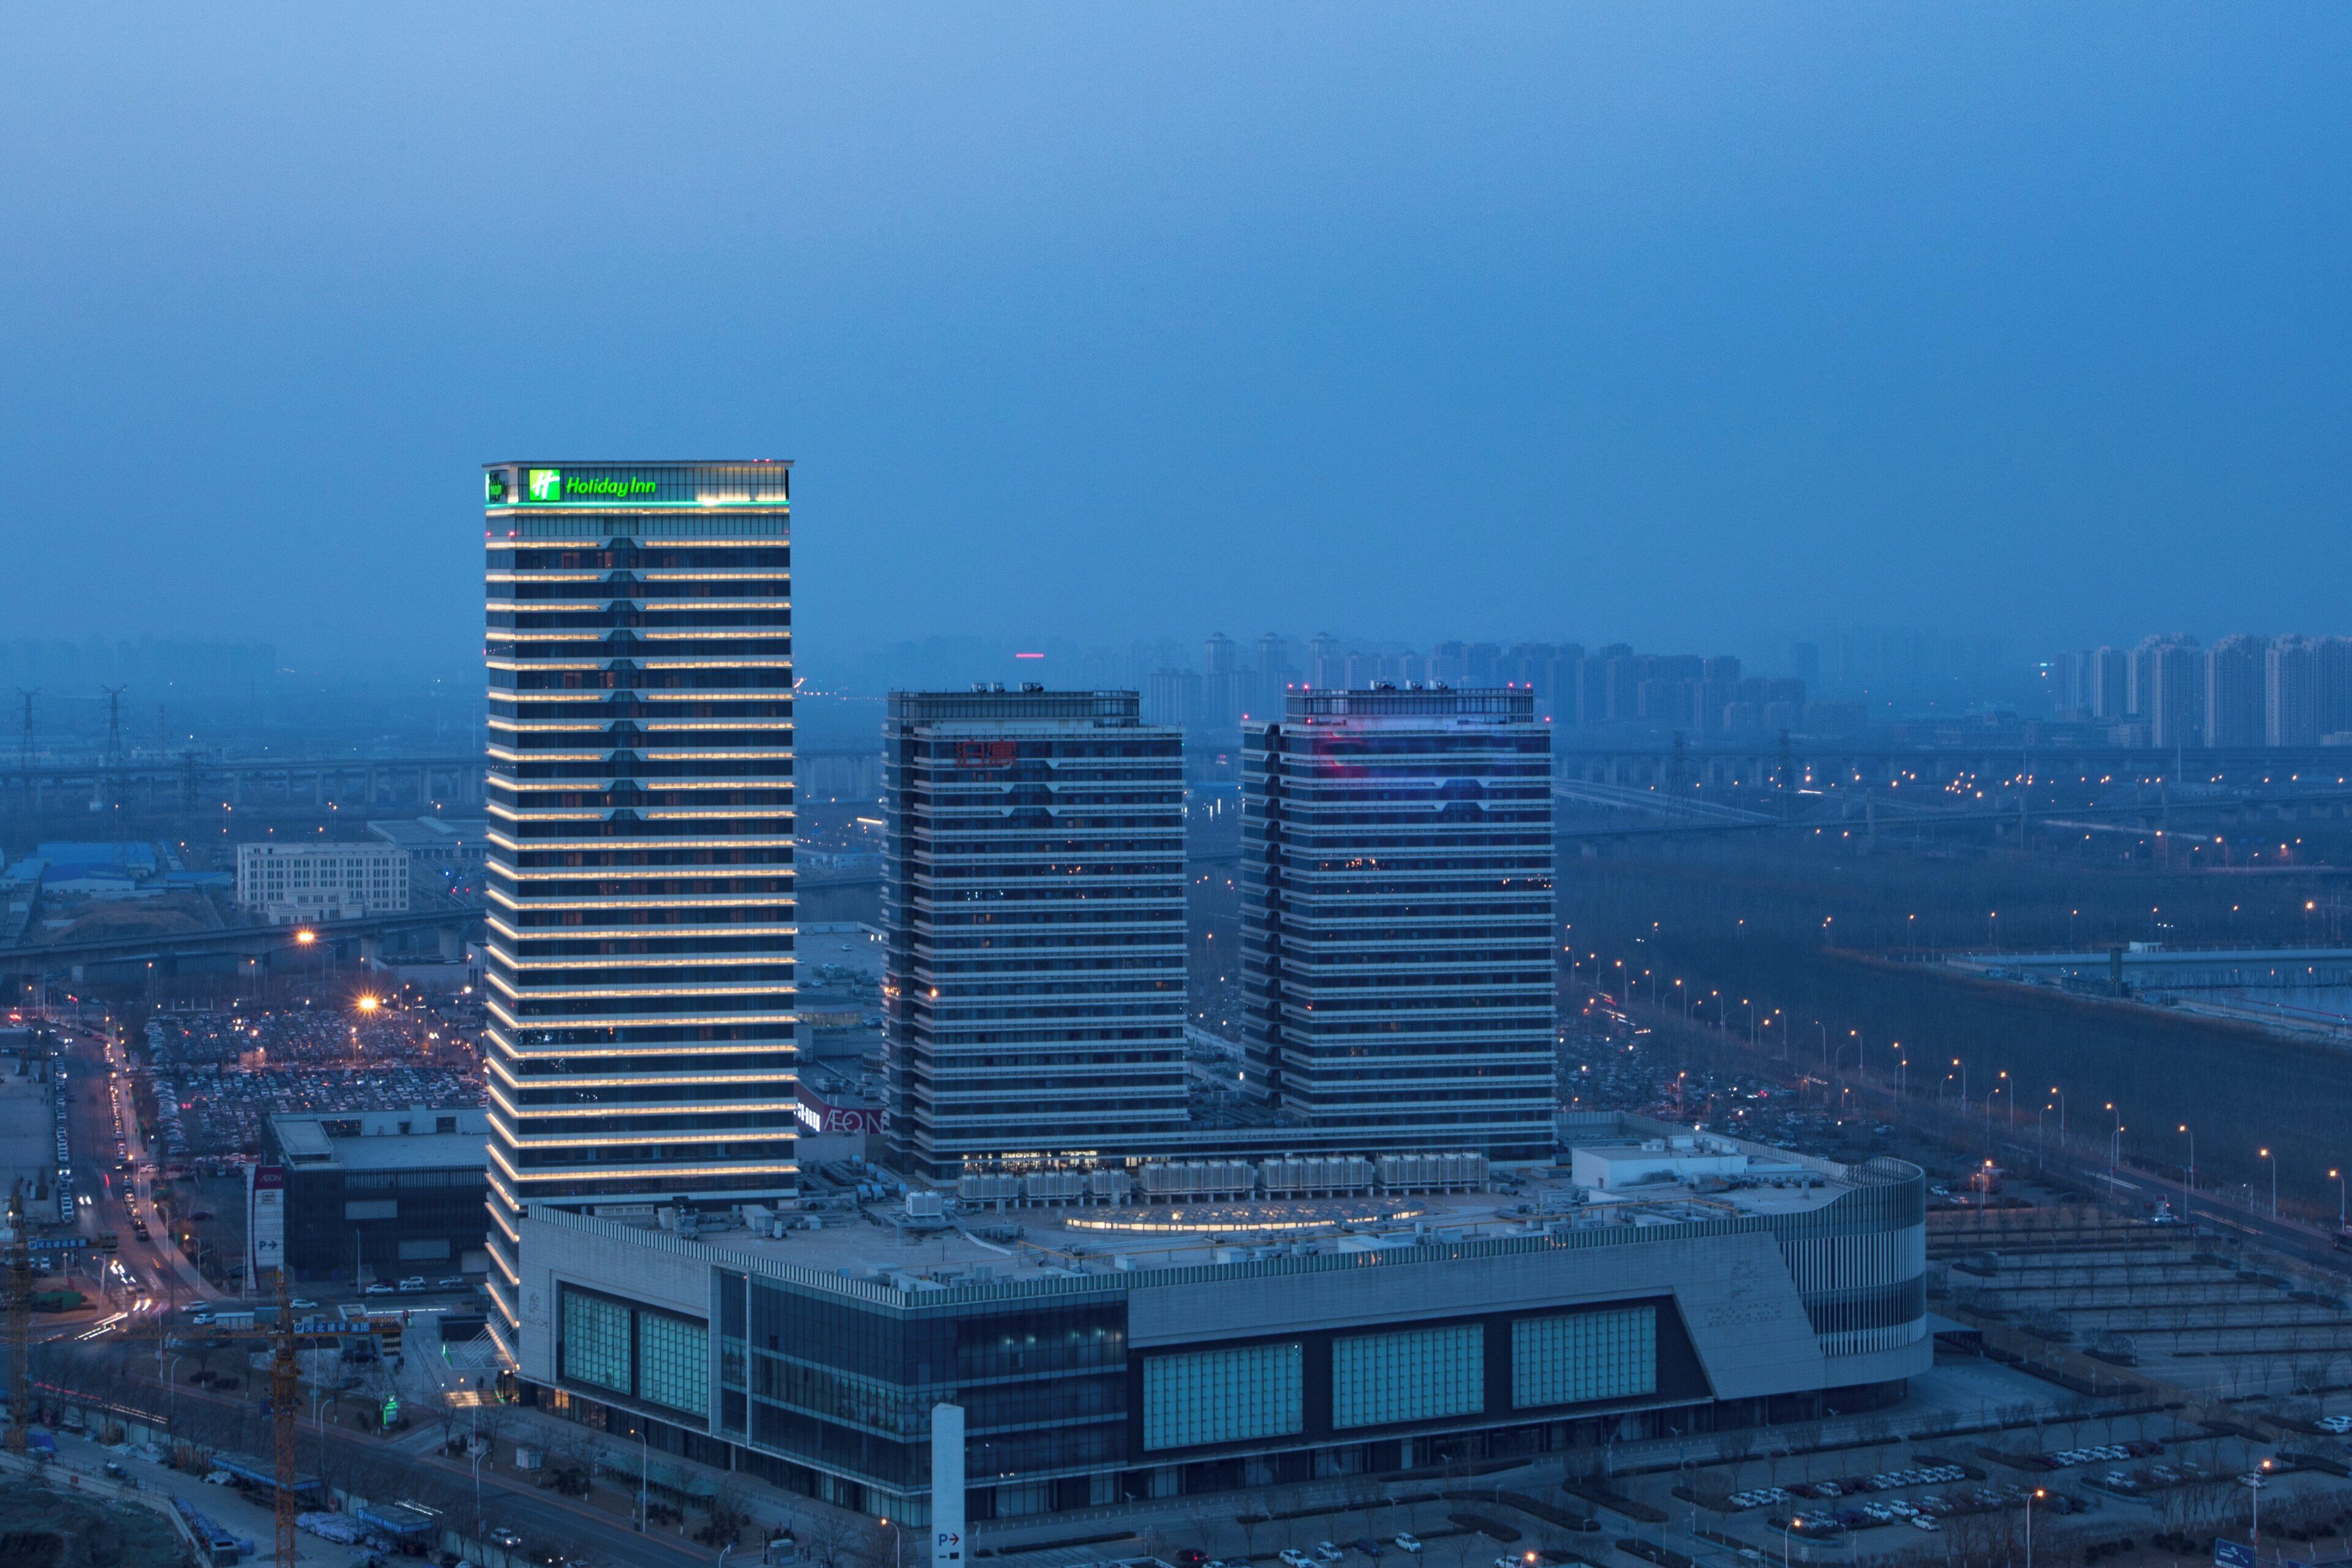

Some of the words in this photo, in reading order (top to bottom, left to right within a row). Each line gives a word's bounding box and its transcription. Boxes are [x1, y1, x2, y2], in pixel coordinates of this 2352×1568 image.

[566, 477, 628, 497] Holiday
[630, 477, 656, 493] Inn
[259, 1241, 266, 1250] P
[306, 1322, 370, 1333] 河北建设集团
[939, 1534, 948, 1547] P
